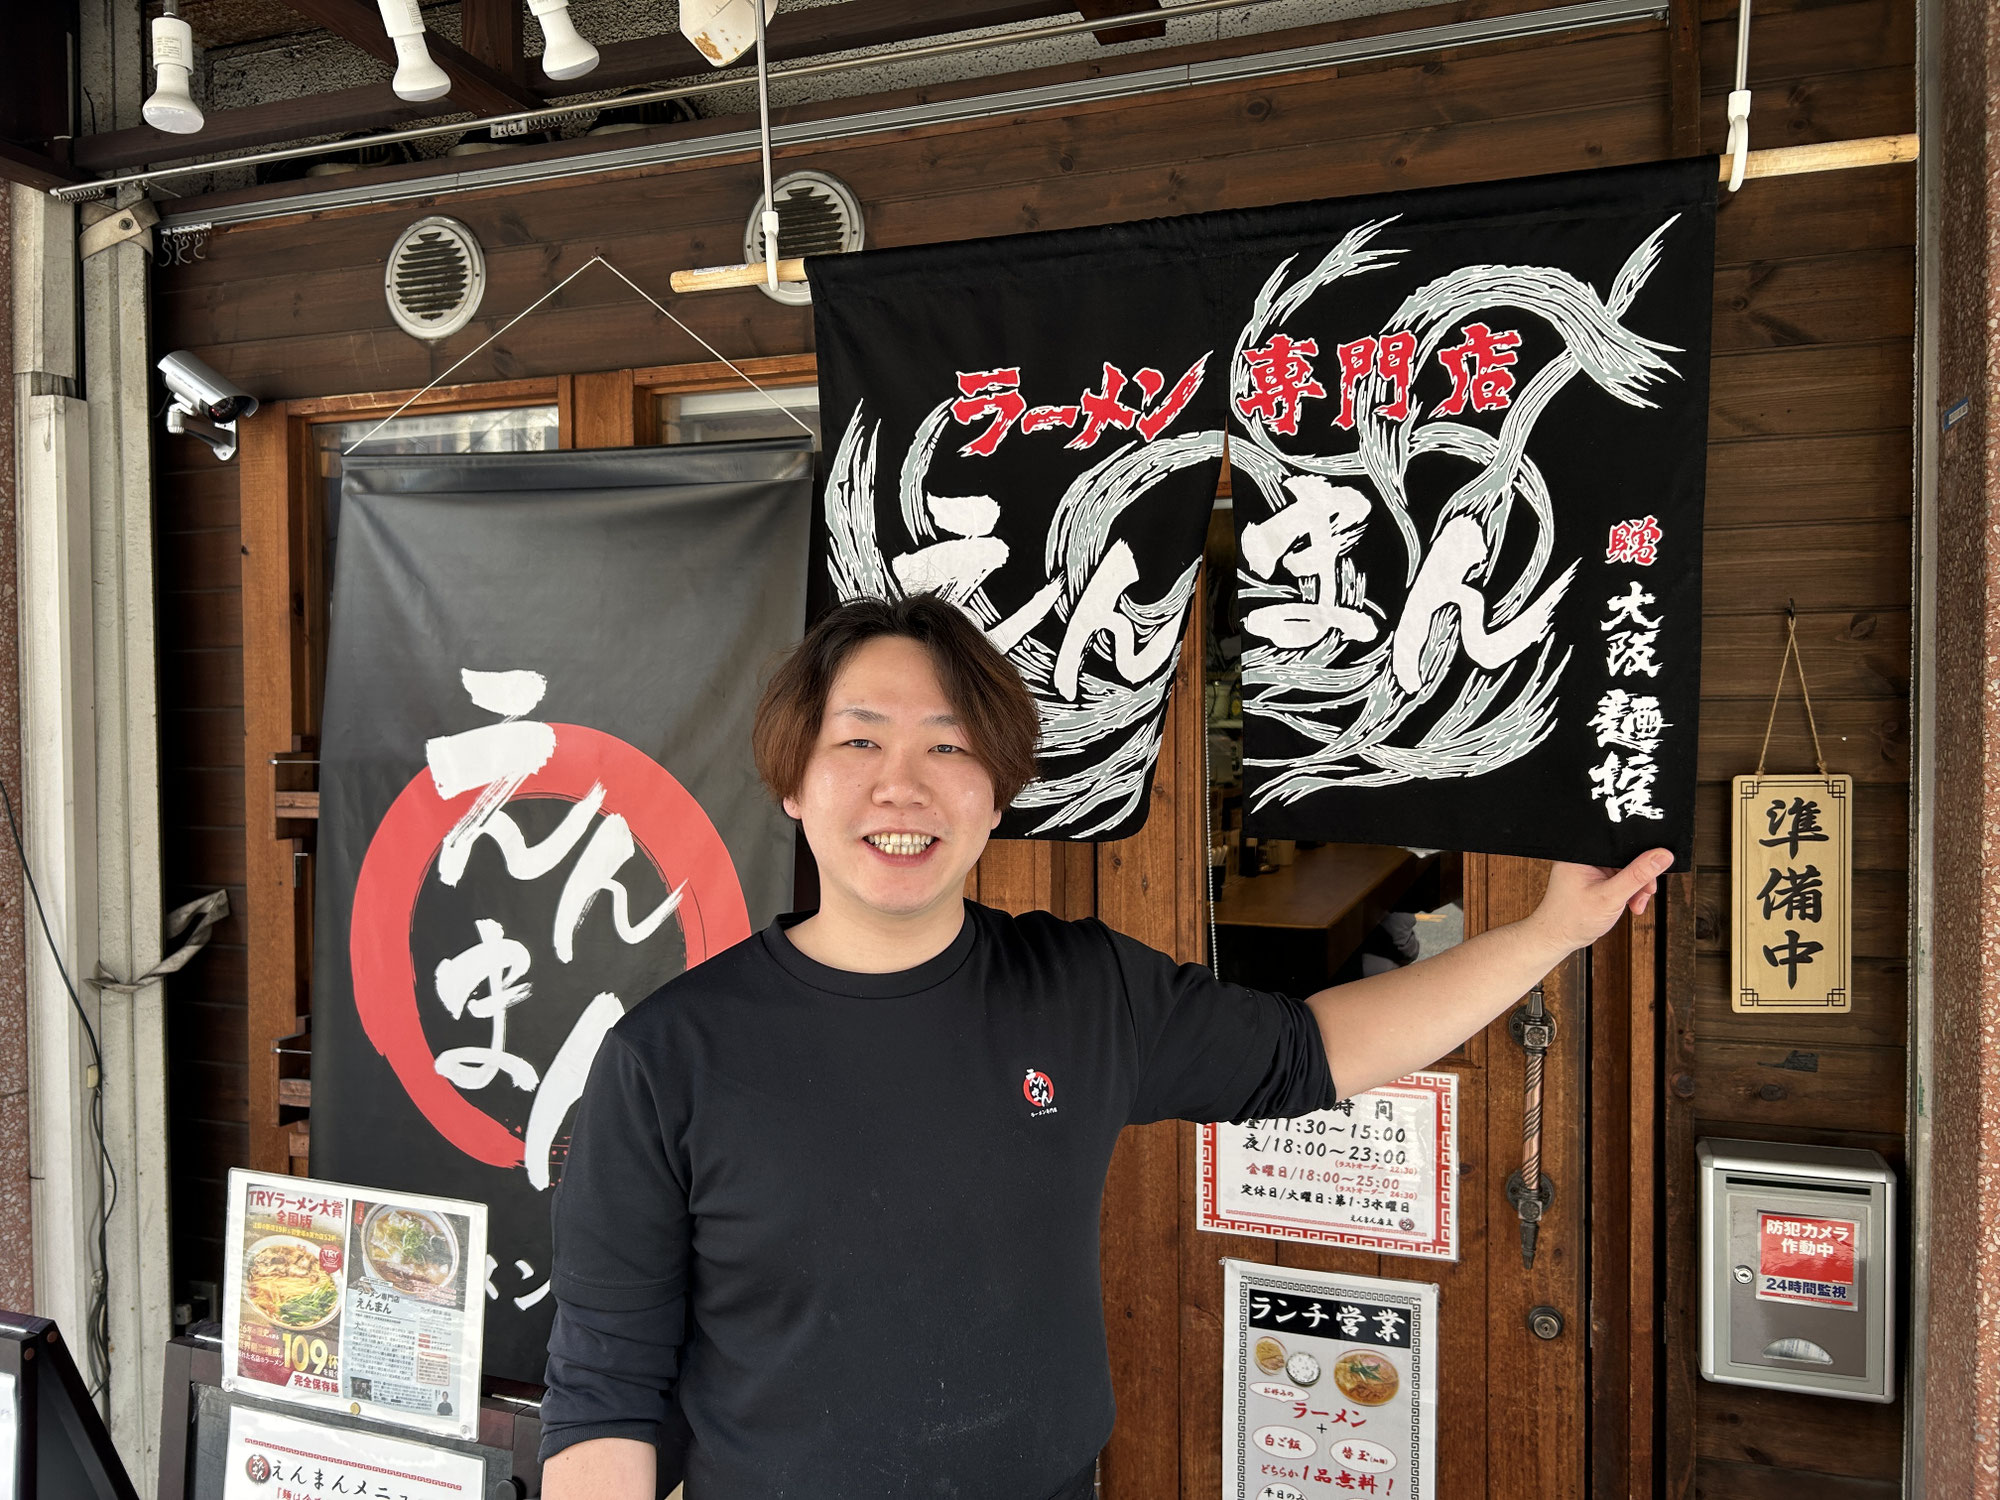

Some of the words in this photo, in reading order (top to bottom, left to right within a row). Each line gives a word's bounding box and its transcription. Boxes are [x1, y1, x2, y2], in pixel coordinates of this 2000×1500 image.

[954, 323, 1522, 457] ラーメン専門店
[1757, 797, 1829, 989] 準備中
[249, 1190, 344, 1219] TRYラーメン大賞
[276, 1210, 313, 1230] 全国版
[1766, 1219, 1849, 1242] 防犯カメラ
[1781, 1237, 1834, 1258] 作動中
[1766, 1278, 1847, 1299] 24時間監視
[1251, 1296, 1406, 1343] ランチ営業
[294, 1374, 339, 1394] 完全保存版
[1292, 1402, 1367, 1428] ラーメン
[1265, 1434, 1302, 1452] 白ご飯
